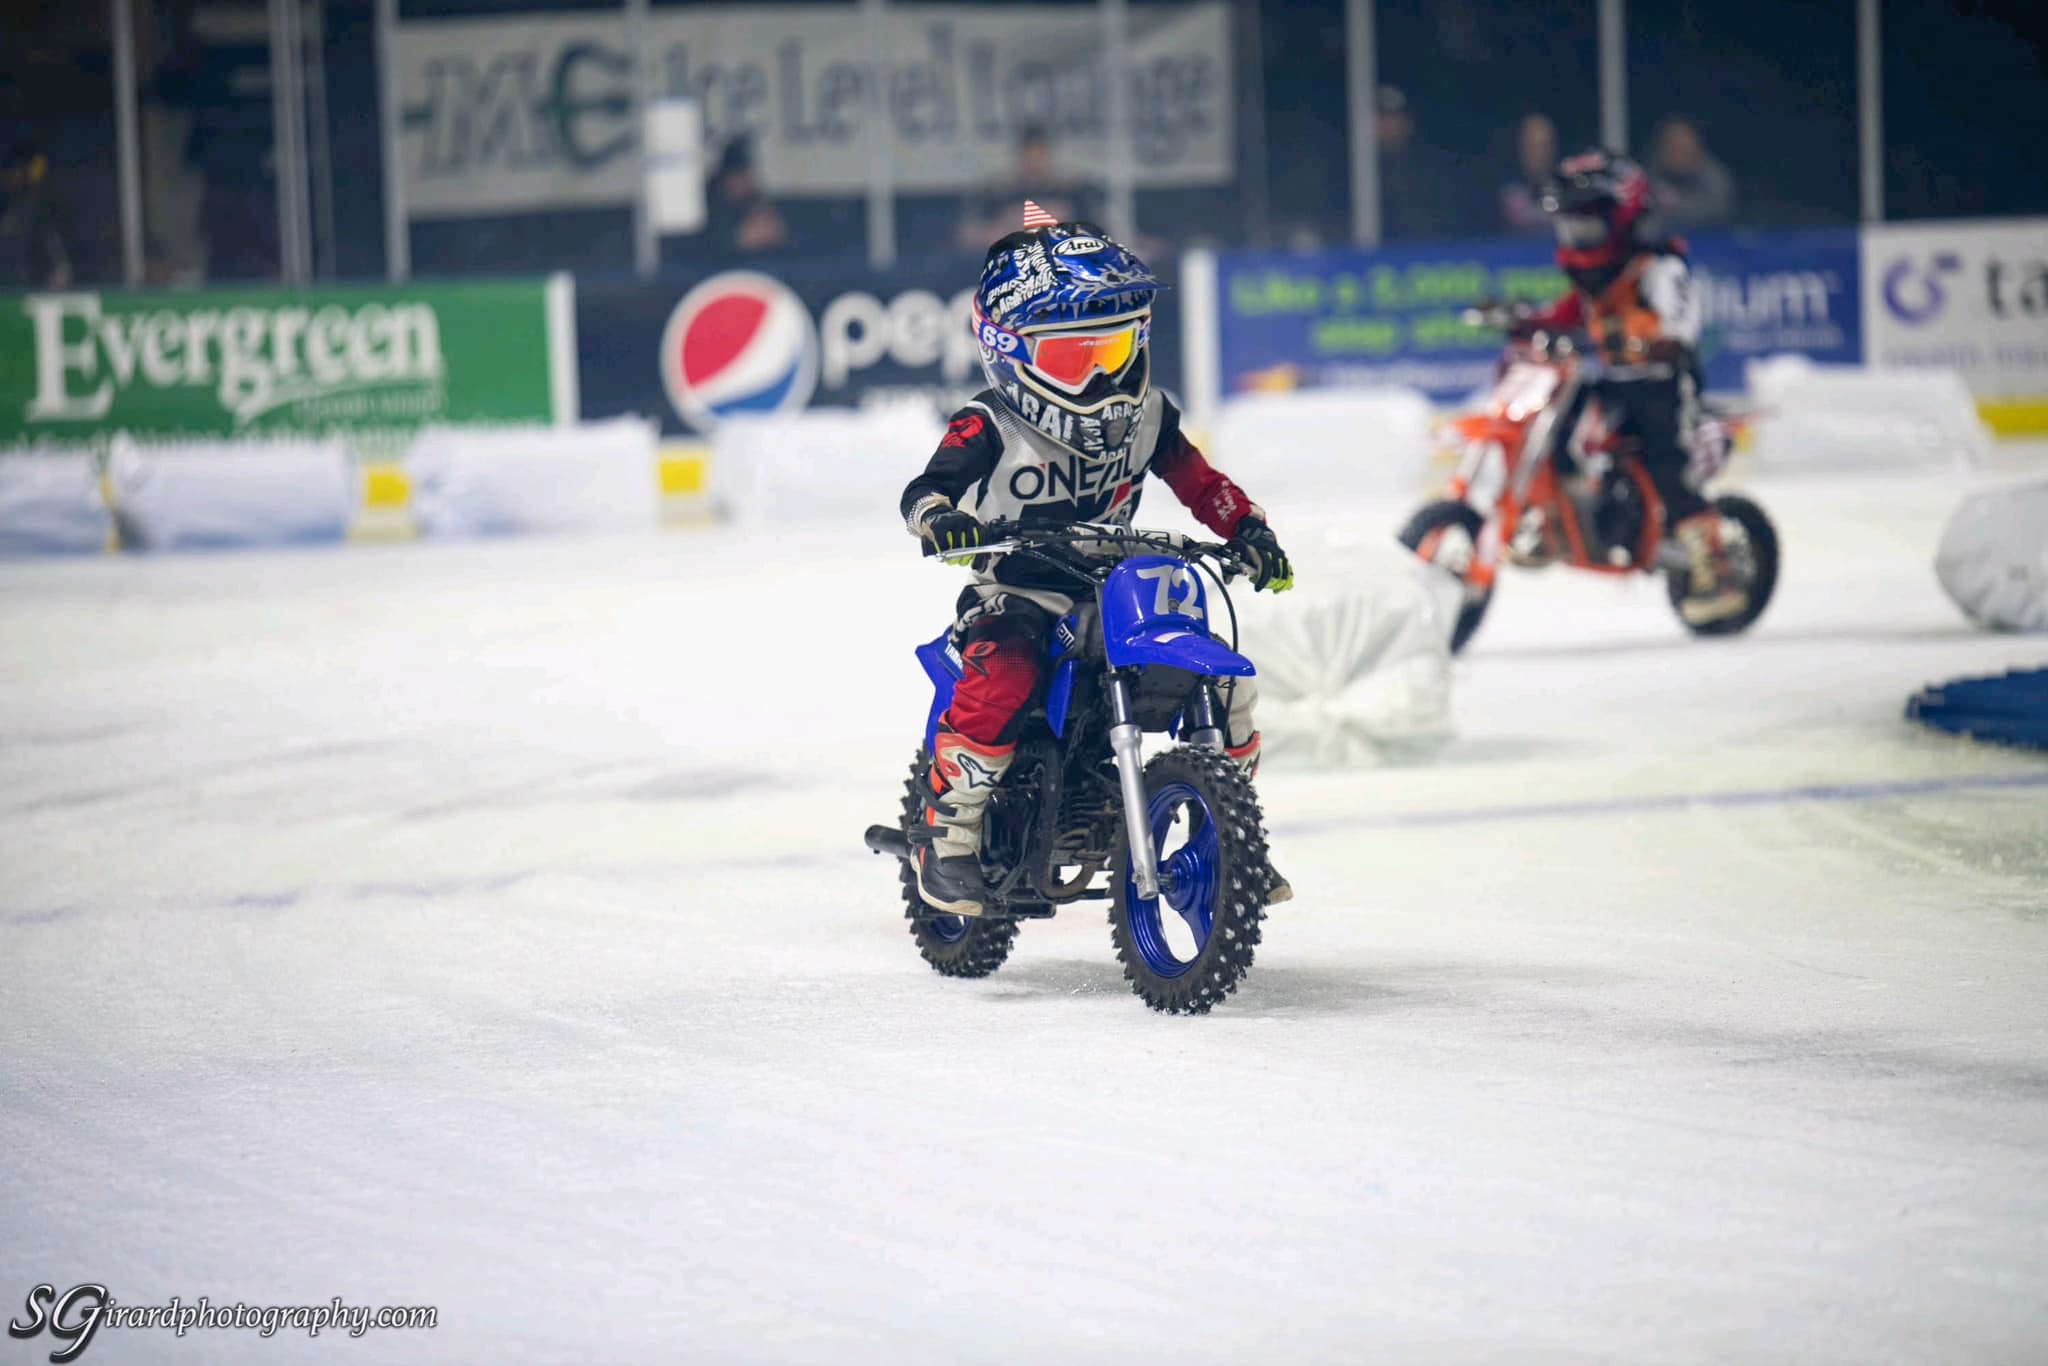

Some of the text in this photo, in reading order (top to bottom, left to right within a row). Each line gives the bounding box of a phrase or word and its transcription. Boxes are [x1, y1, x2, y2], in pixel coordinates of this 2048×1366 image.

[780, 19, 958, 145] Level
[25, 291, 444, 426] Evergreen
[821, 288, 978, 389] pep
[982, 324, 1019, 353] 69
[1136, 564, 1204, 619] 72
